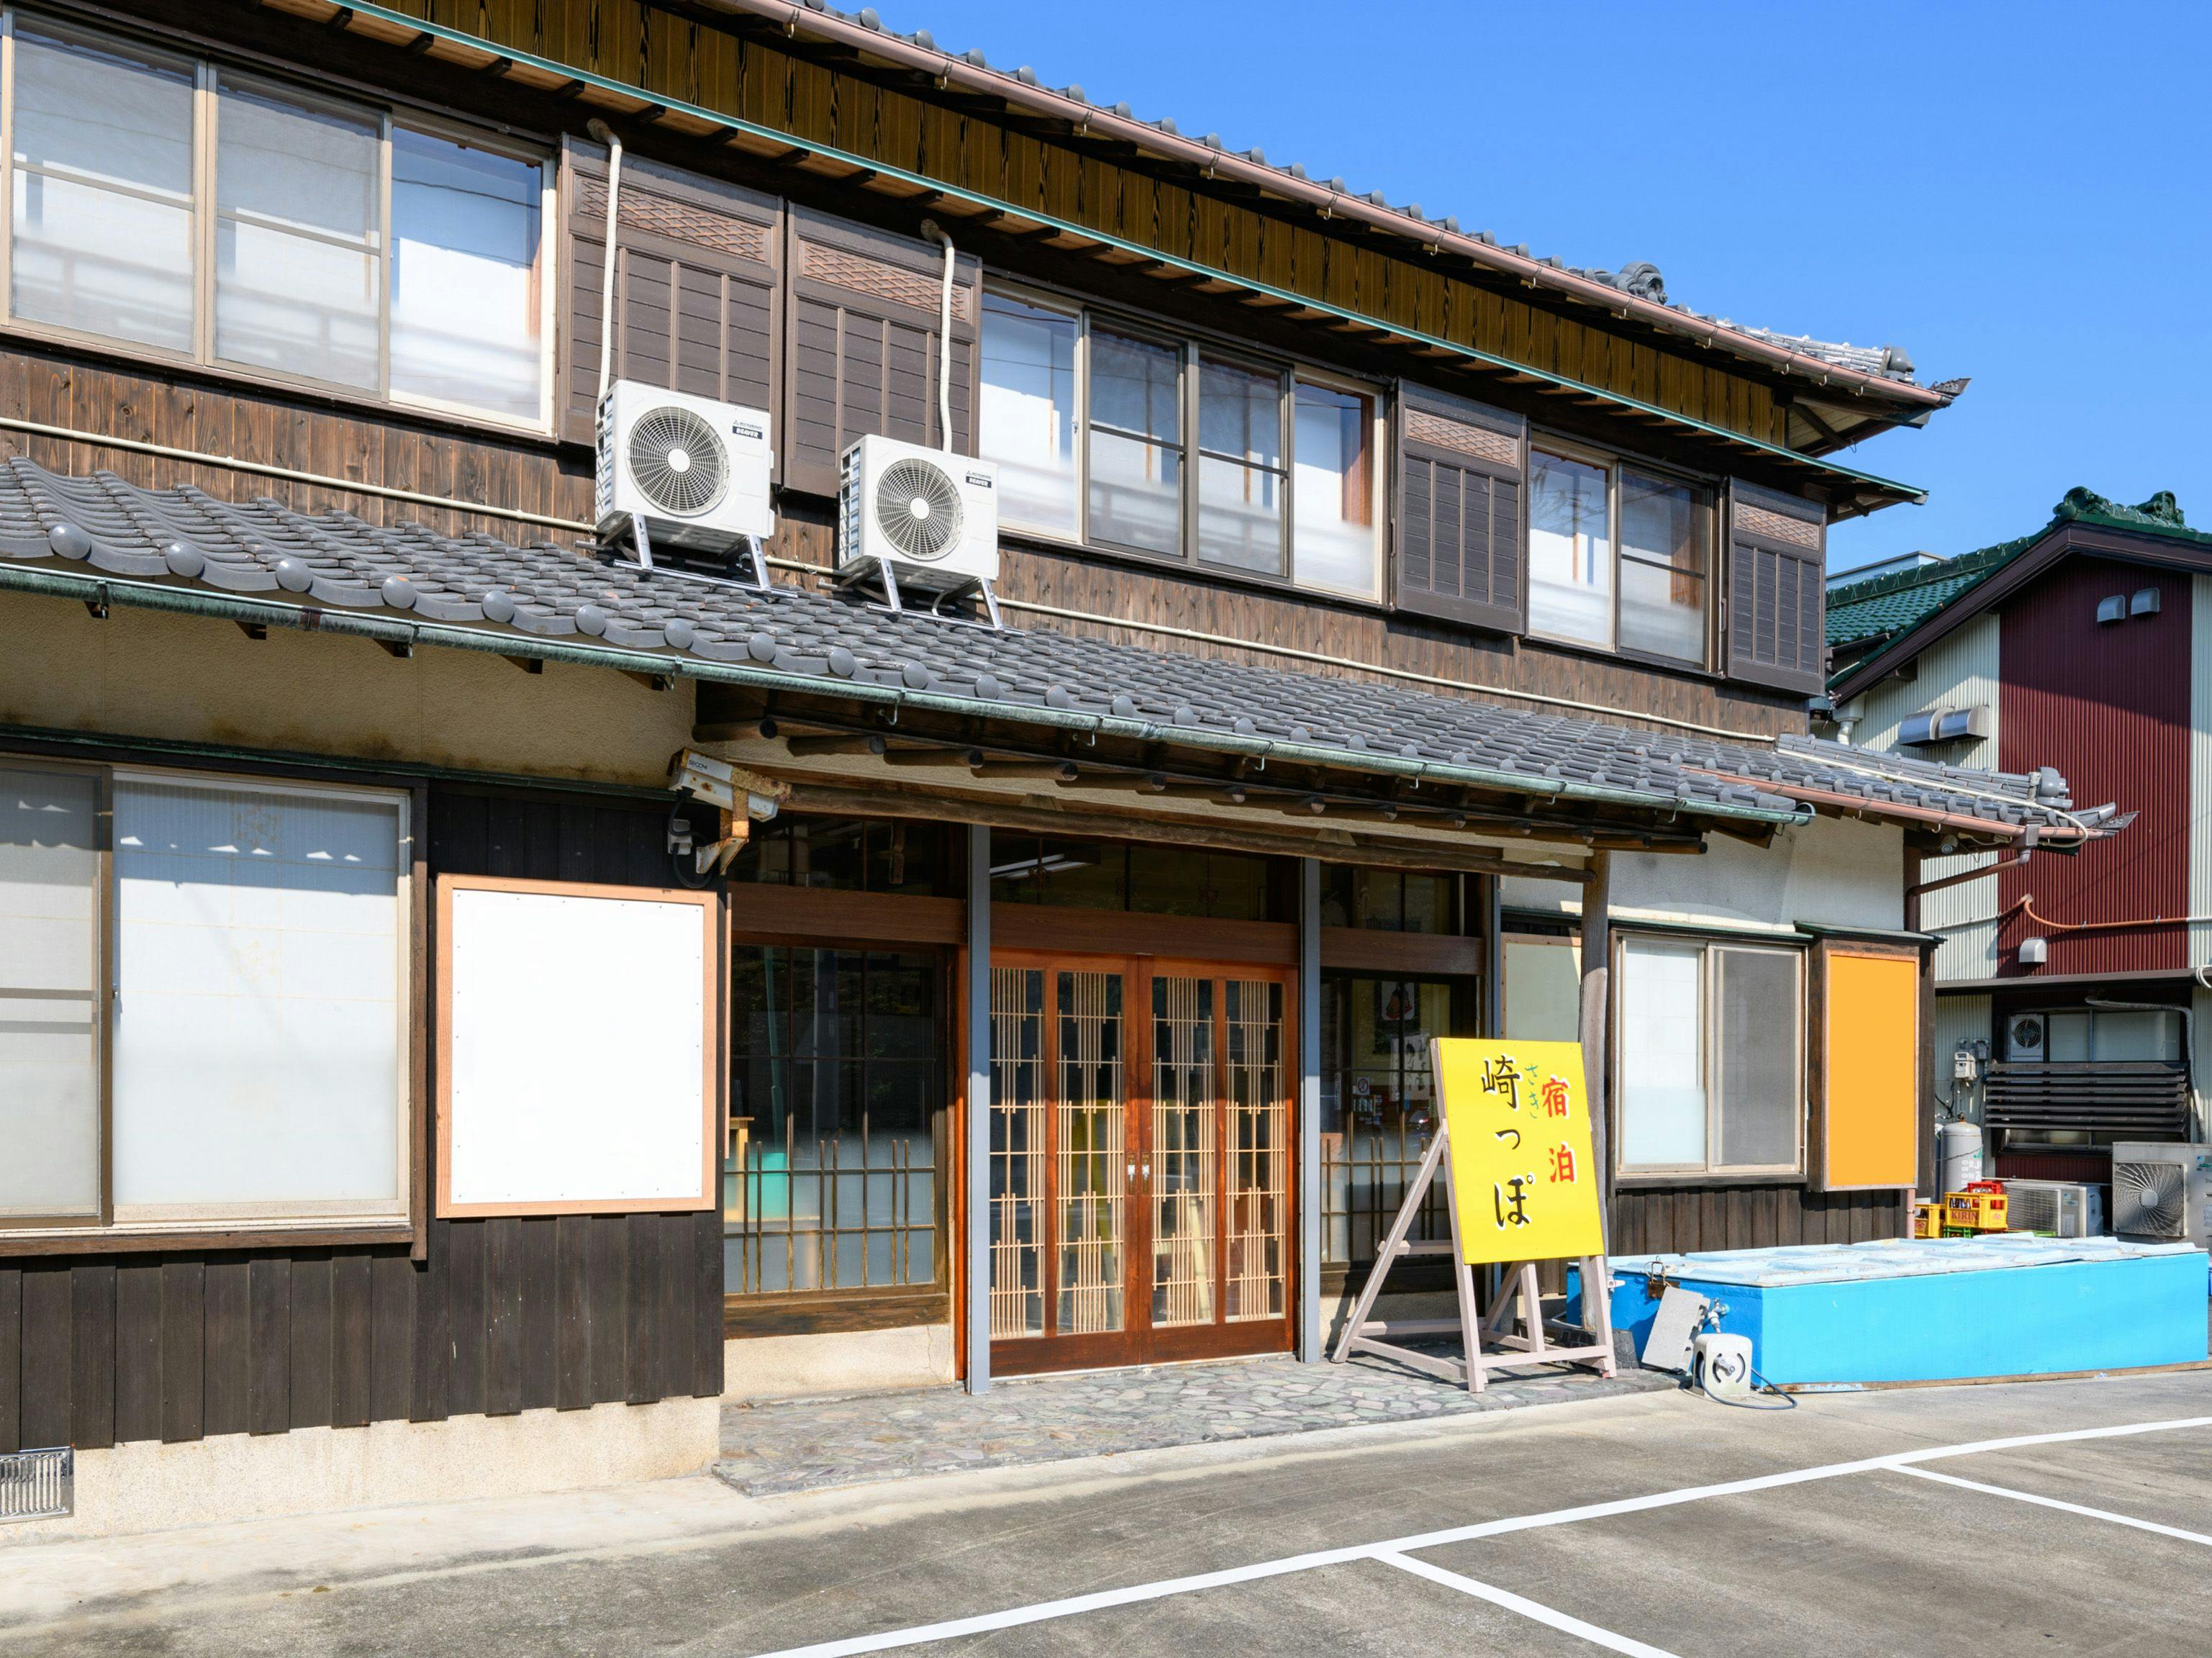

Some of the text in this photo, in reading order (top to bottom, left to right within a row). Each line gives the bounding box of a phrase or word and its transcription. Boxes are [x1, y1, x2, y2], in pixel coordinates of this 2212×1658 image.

[736, 427, 759, 438] BEAVER
[1524, 1063, 1539, 1119] さき
[1481, 1054, 1534, 1228] 崎っぽ
[1541, 1077, 1575, 1184] 宿泊
[1951, 1210, 1977, 1221] KIRIN
